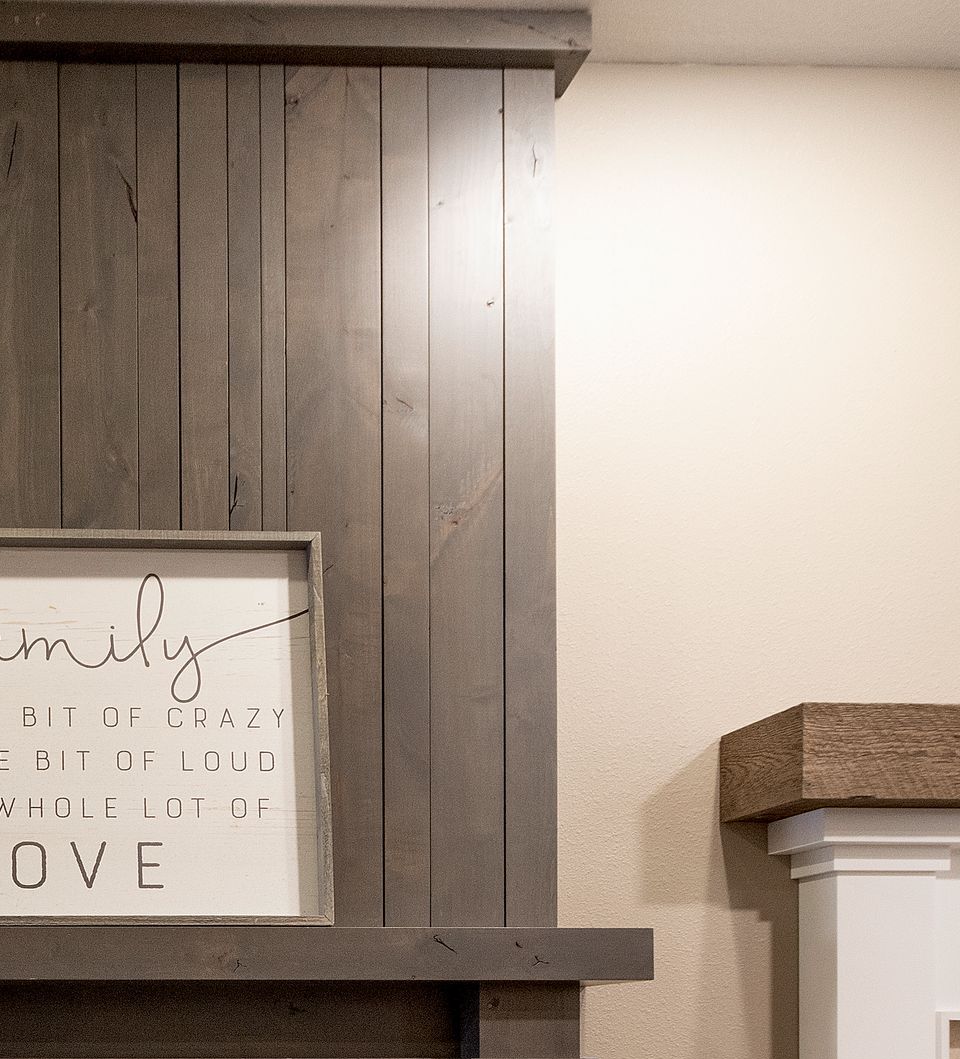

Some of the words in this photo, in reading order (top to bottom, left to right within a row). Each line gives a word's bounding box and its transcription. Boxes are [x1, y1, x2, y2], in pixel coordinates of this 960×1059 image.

[22, 706, 77, 728] BIT
[102, 706, 142, 728] OF
[167, 707, 285, 729] CRAZY
[36, 749, 90, 771] BIT
[116, 750, 155, 772] OF
[181, 750, 275, 772] LOUD
[143, 797, 205, 819] LOT
[231, 797, 270, 819] OF
